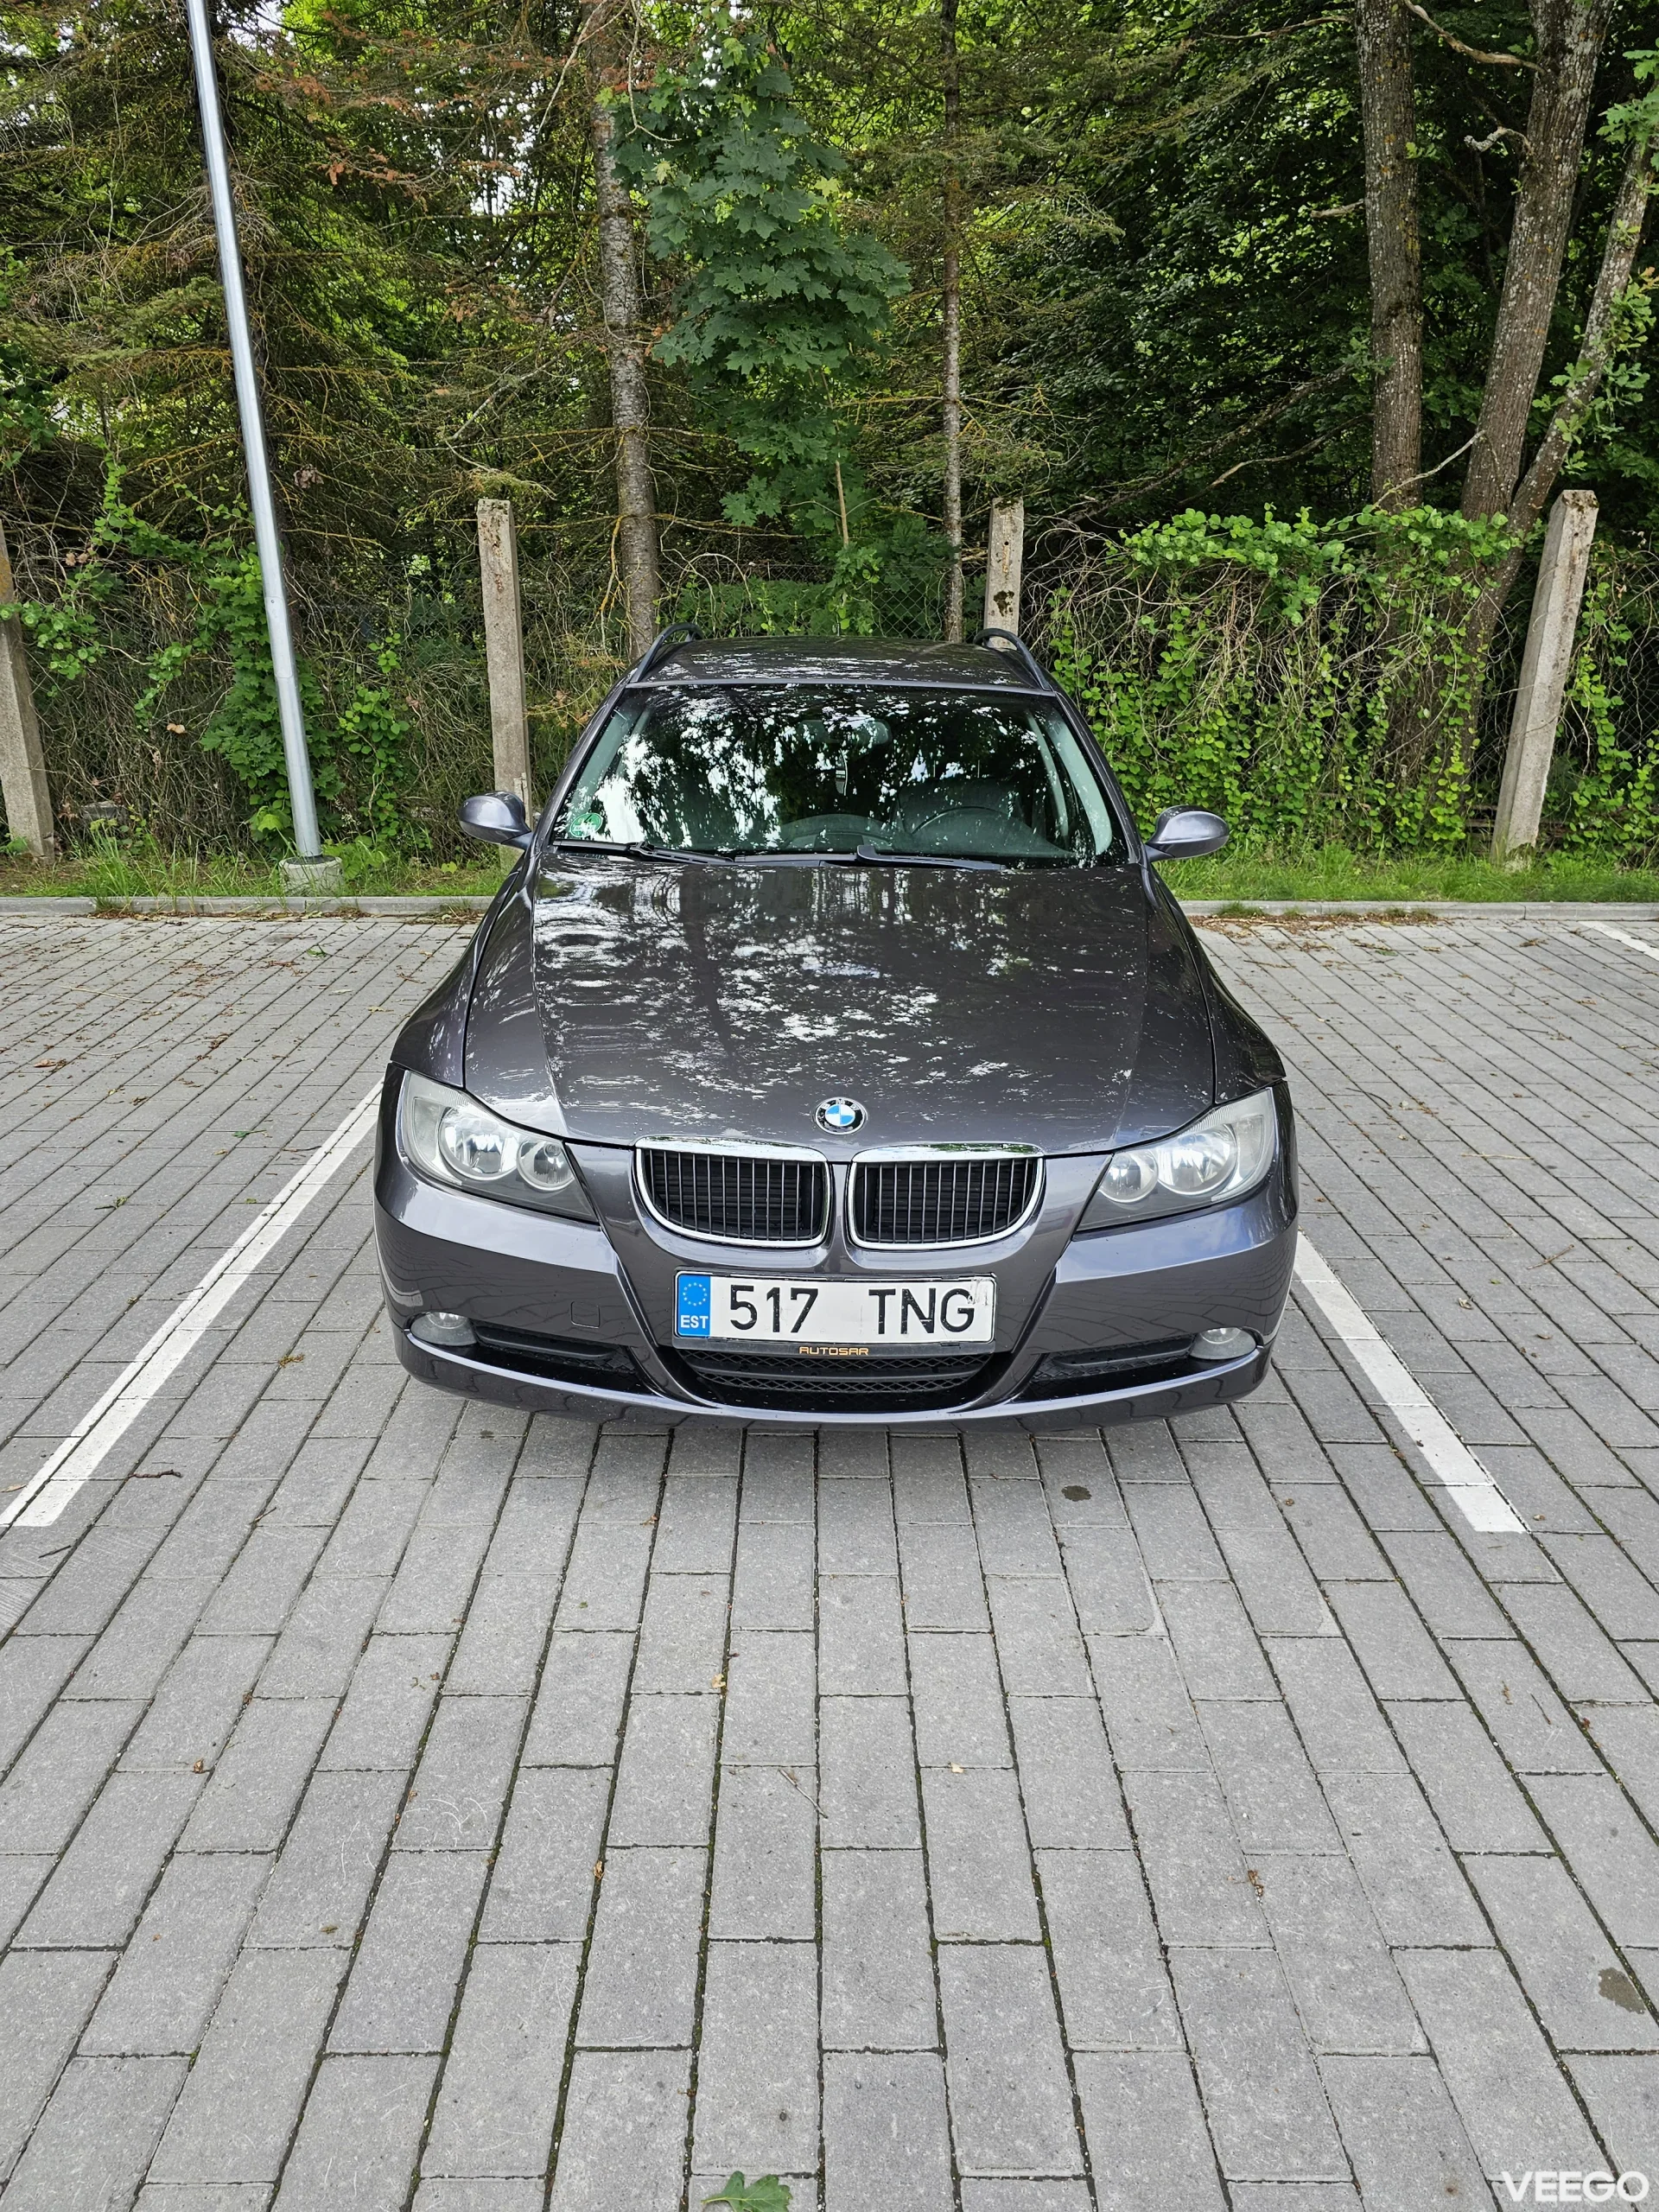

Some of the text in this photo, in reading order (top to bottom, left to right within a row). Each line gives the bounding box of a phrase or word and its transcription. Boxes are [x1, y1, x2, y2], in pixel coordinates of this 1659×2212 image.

[820, 1097, 860, 1111] BMW
[730, 1285, 976, 1335] 517 TNG
[680, 1314, 709, 1329] EST
[799, 1346, 869, 1356] AUTOSAR
